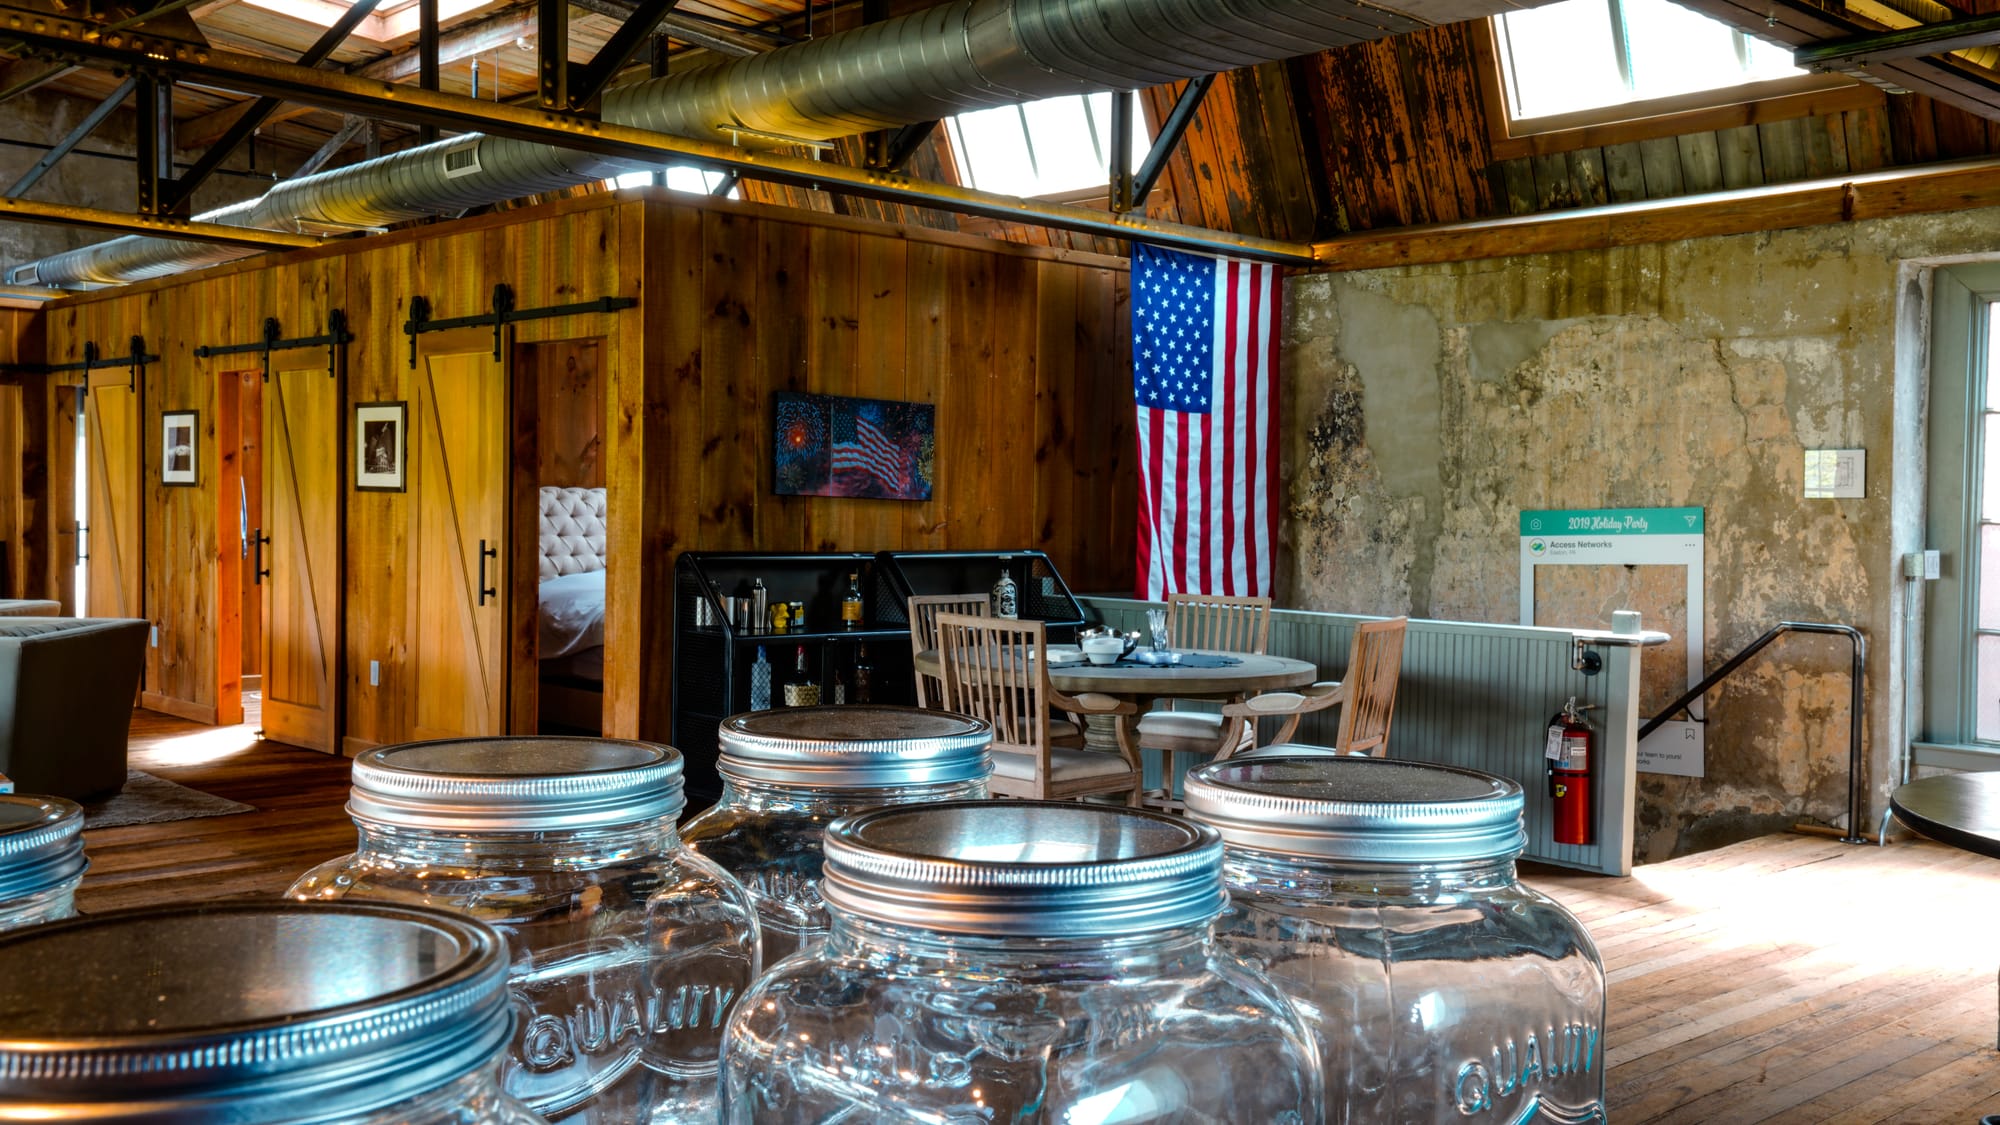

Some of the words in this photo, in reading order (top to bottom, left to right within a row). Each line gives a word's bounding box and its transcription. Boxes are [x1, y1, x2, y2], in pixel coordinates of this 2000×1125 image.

[1550, 541, 1576, 549] Access
[1578, 541, 1612, 549] Networks
[1568, 517, 1590, 529] 2019
[1591, 516, 1622, 532] Holiday
[1624, 516, 1648, 533] Party
[523, 984, 735, 1070] QUALITY
[1456, 1022, 1599, 1116] QUALITY
